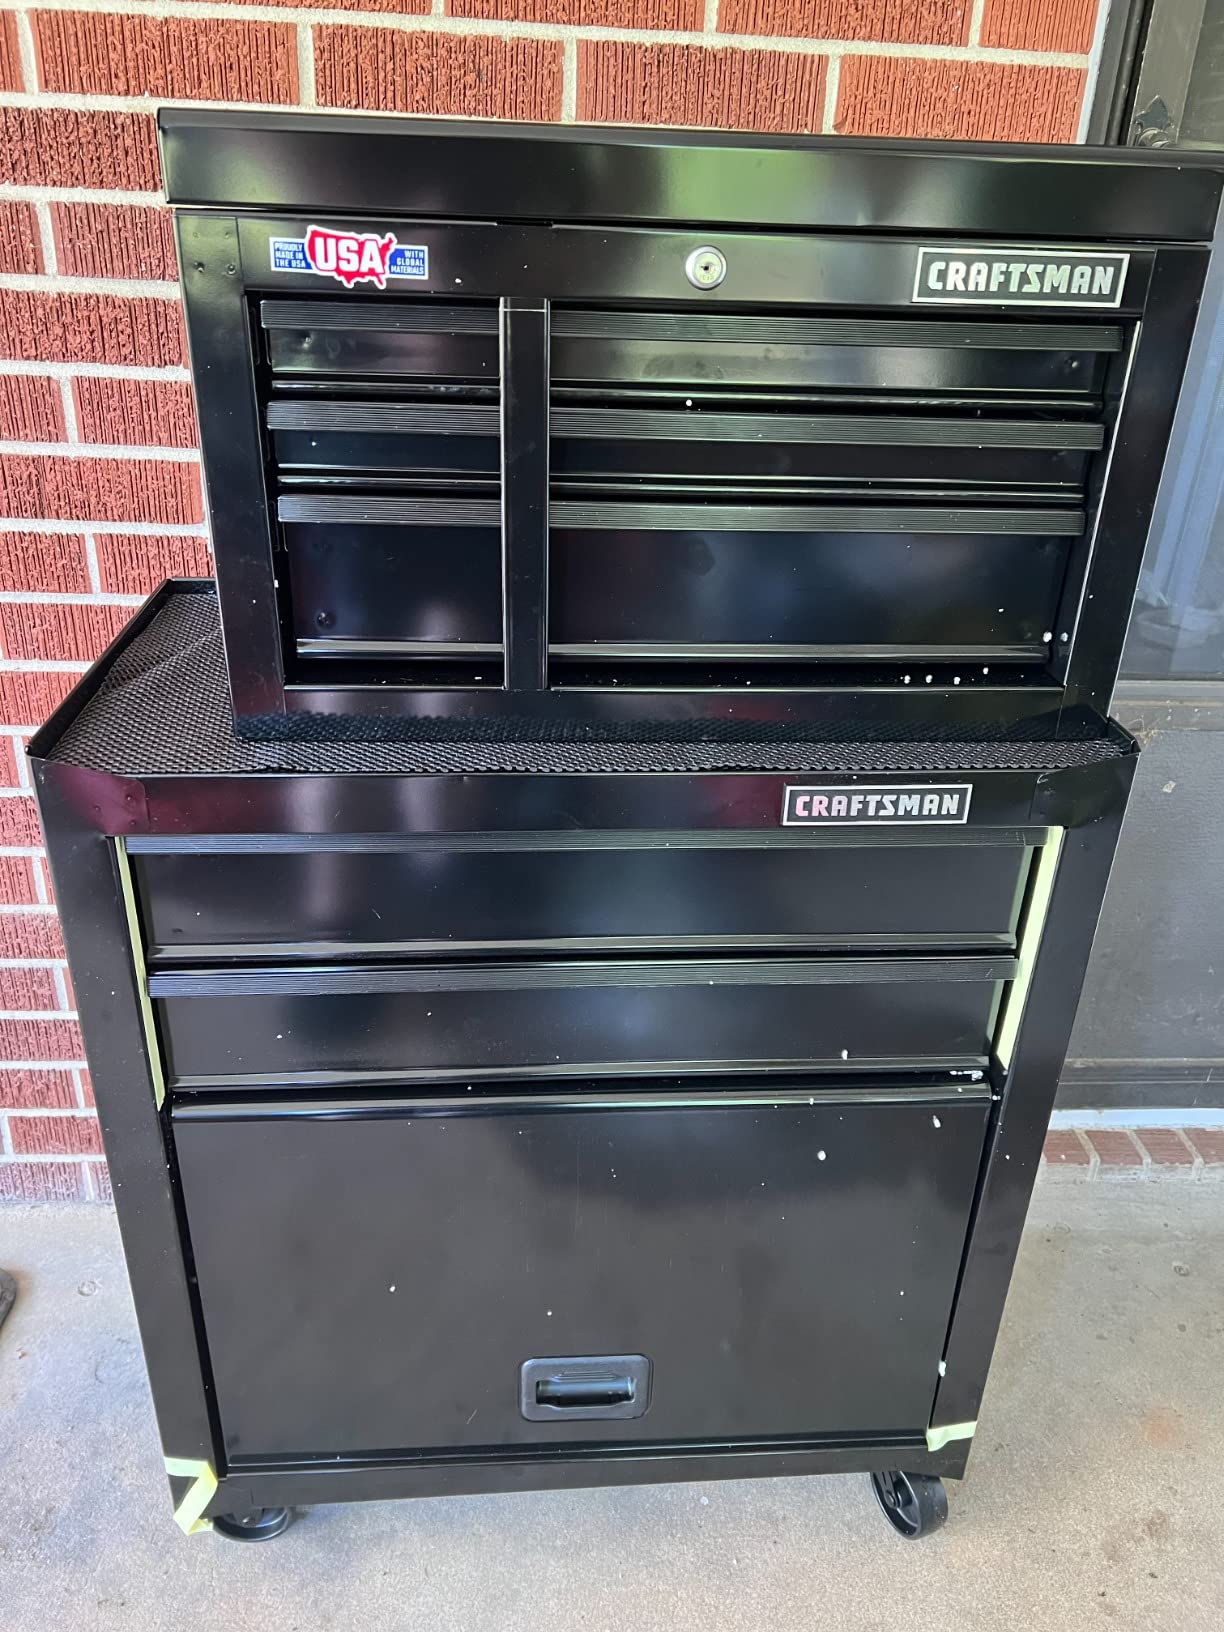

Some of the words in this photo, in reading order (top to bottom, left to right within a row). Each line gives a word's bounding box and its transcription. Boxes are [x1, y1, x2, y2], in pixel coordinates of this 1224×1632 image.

[274, 242, 303, 251] PROUDLY
[275, 250, 293, 259] MADE
[295, 252, 304, 260] IN
[314, 237, 385, 274] USA
[405, 250, 424, 258] WITH
[275, 259, 289, 267] THE
[291, 260, 306, 268] USA
[396, 258, 424, 266] GLOBAL
[391, 266, 425, 275] MATERIALS
[927, 261, 1114, 295] CRAFTSMAN
[795, 794, 960, 817] CRAFTSMAN
